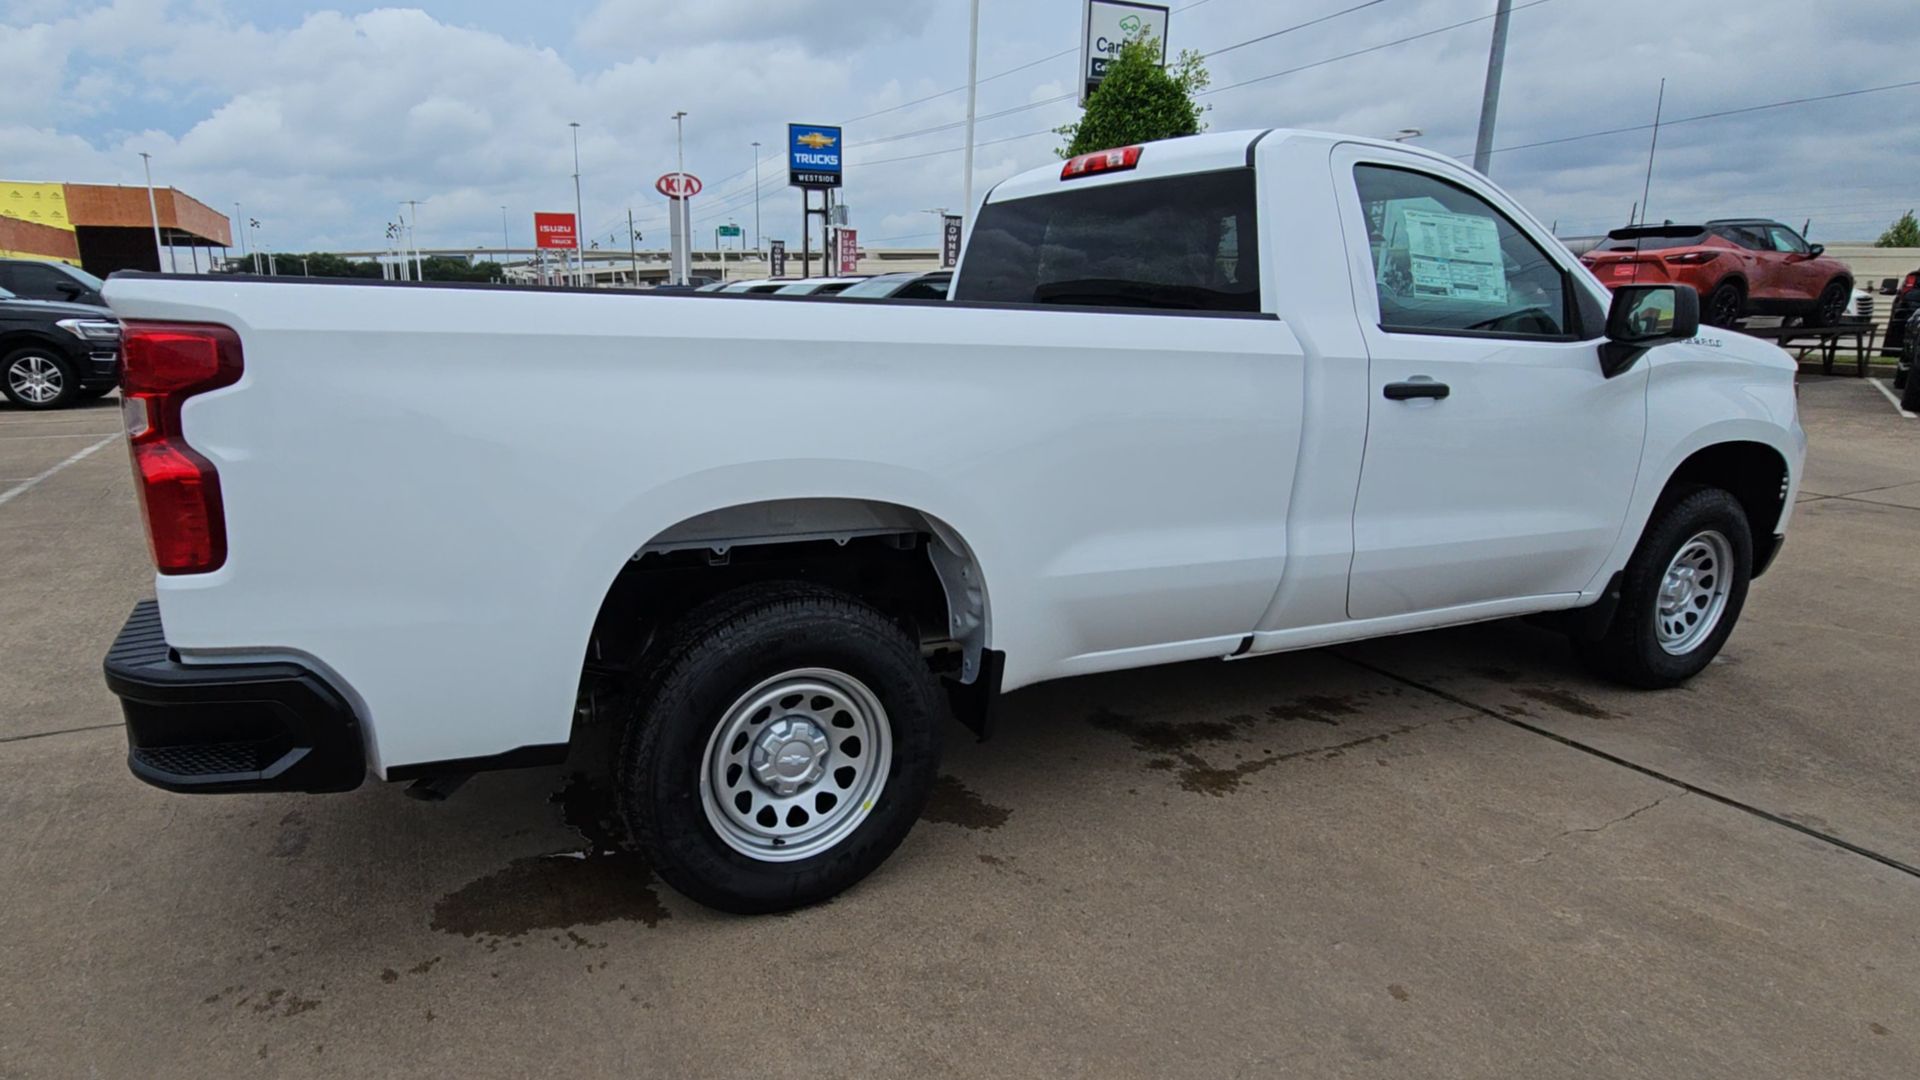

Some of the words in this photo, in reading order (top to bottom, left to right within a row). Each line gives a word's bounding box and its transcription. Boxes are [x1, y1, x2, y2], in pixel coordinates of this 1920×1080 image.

[794, 153, 838, 165] TRUCKS
[798, 174, 835, 183] WESTSIDE
[945, 218, 961, 227] PRE
[539, 225, 571, 233] ISUZU
[947, 226, 958, 266] OWNED
[848, 240, 856, 270] CARS
